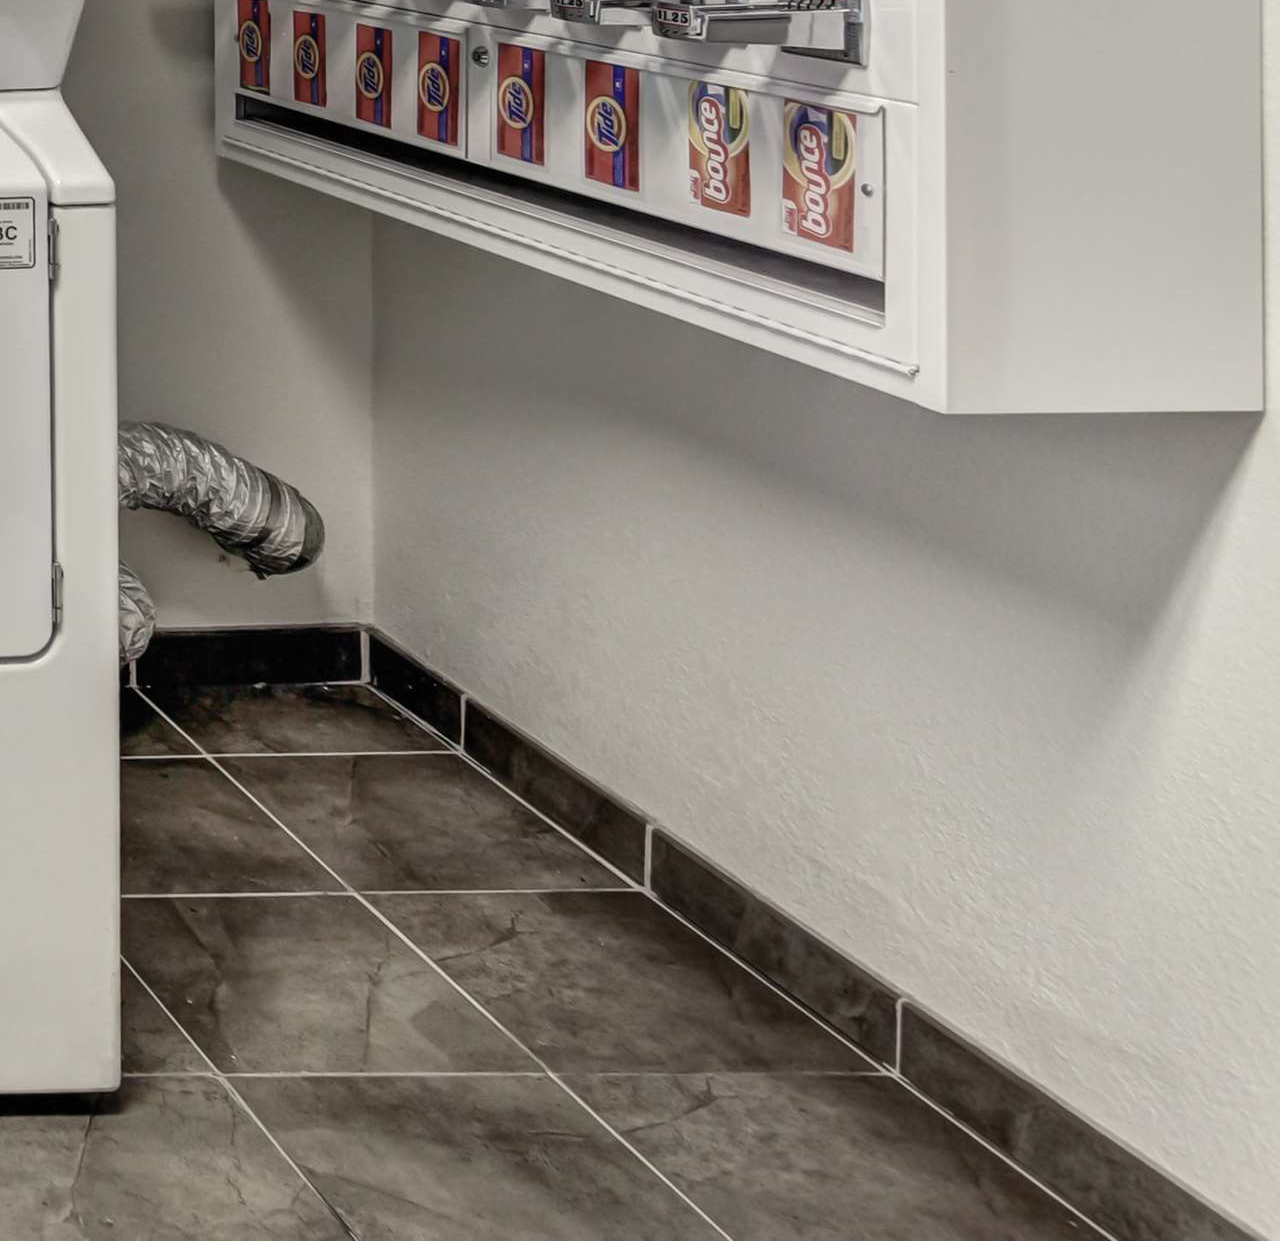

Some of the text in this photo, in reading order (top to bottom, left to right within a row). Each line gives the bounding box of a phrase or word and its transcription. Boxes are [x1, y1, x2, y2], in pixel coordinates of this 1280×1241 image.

[244, 24, 258, 57] Tide
[302, 39, 315, 74] Tide
[363, 58, 378, 94] Tide
[426, 68, 444, 107] Tide
[507, 81, 527, 125] Tide
[596, 101, 620, 147] Tide
[700, 100, 728, 202] bounce
[800, 128, 828, 236] bounce
